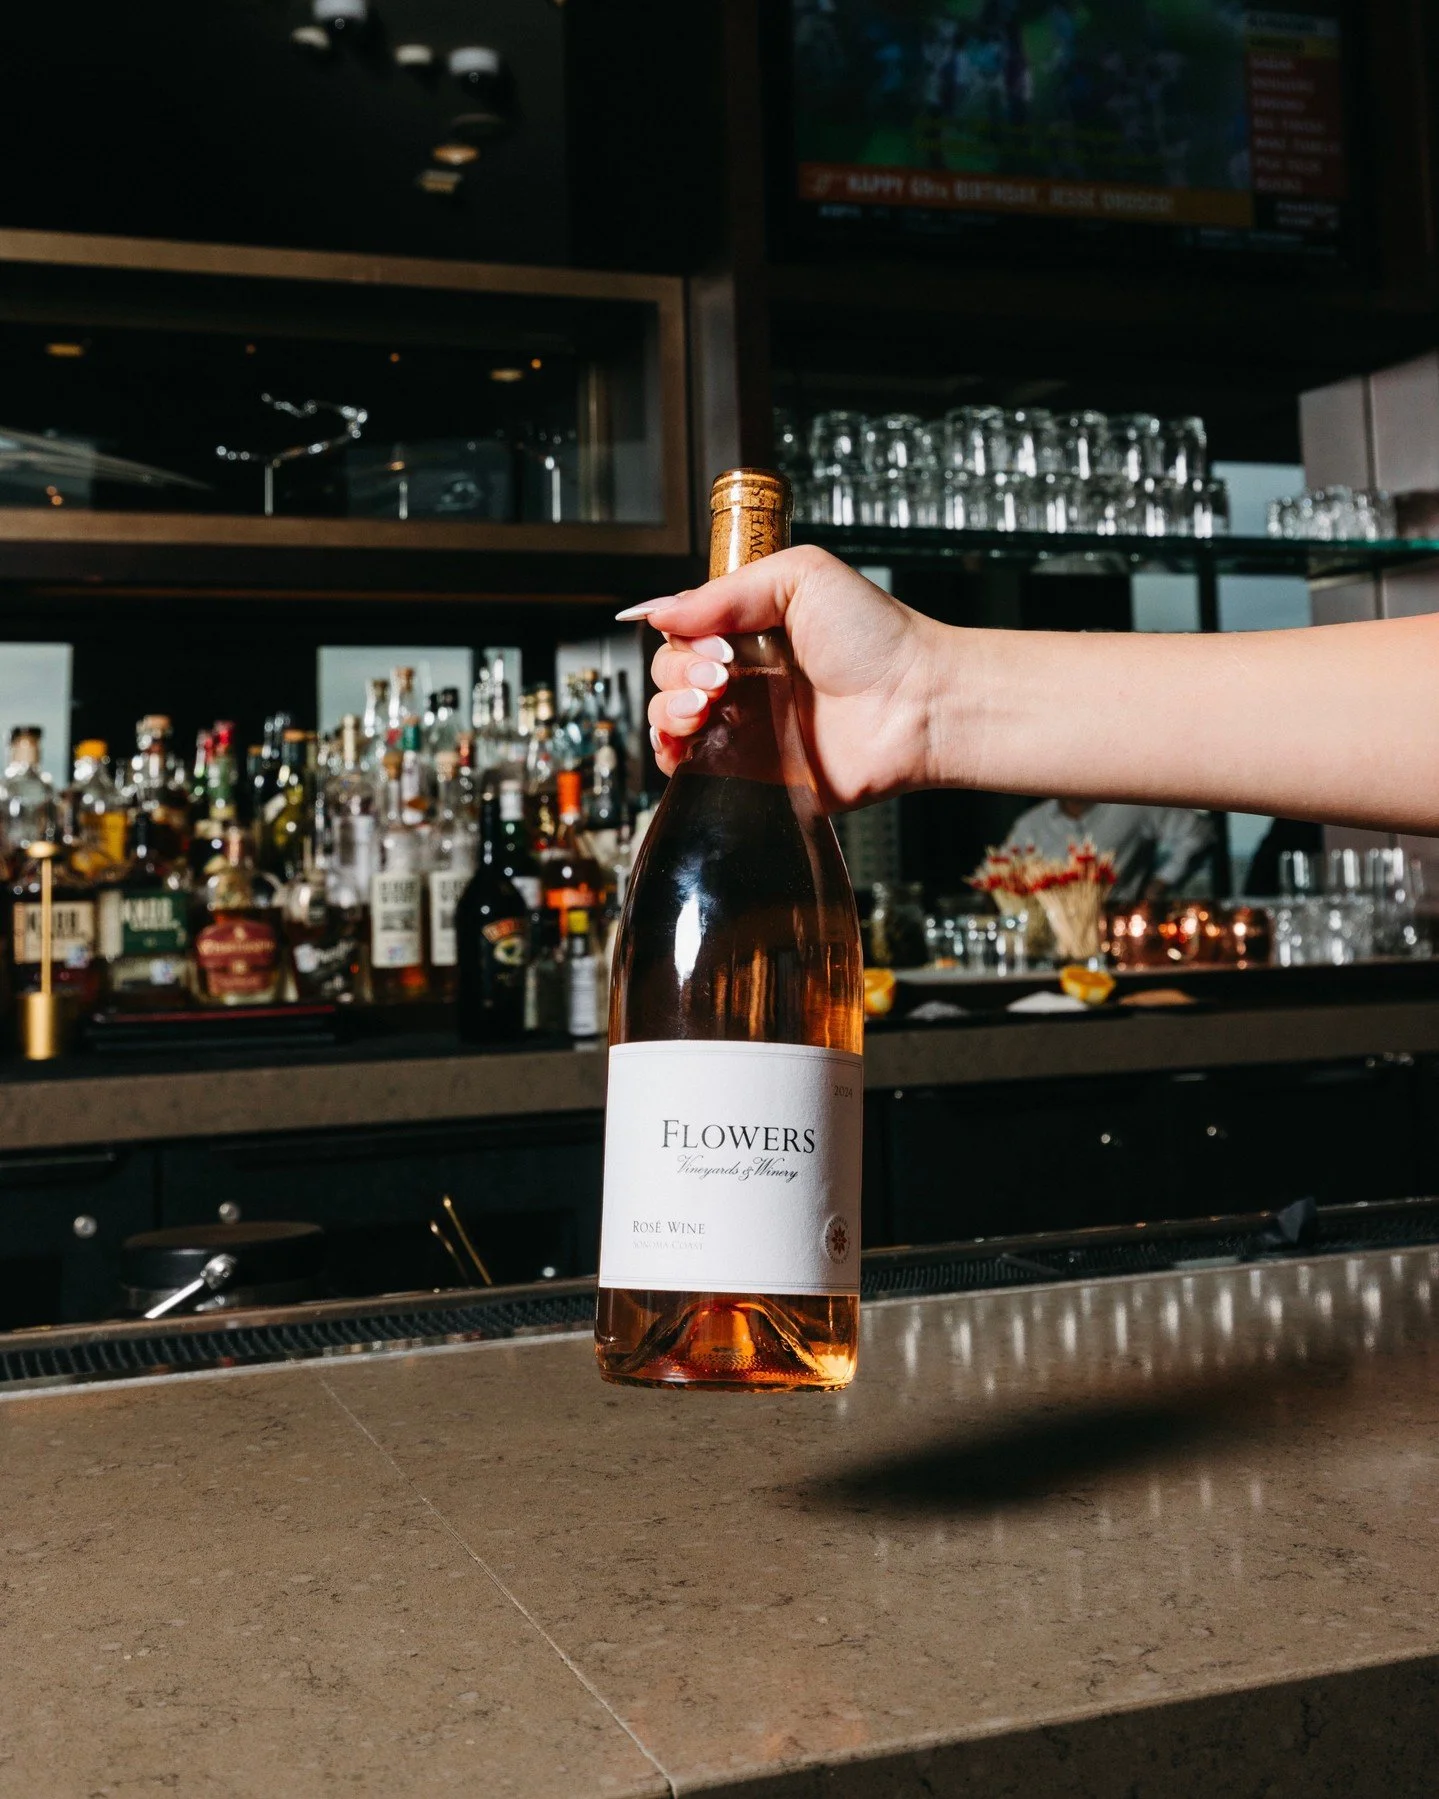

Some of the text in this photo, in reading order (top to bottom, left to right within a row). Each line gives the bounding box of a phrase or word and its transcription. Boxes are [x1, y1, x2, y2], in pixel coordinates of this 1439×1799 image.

[833, 1085, 853, 1098] 2024
[661, 1119, 816, 1154] FLOWERS
[677, 1155, 739, 1180] Vineyards
[753, 1157, 799, 1183] Winery
[632, 1219, 706, 1235] ROSÉ WINE
